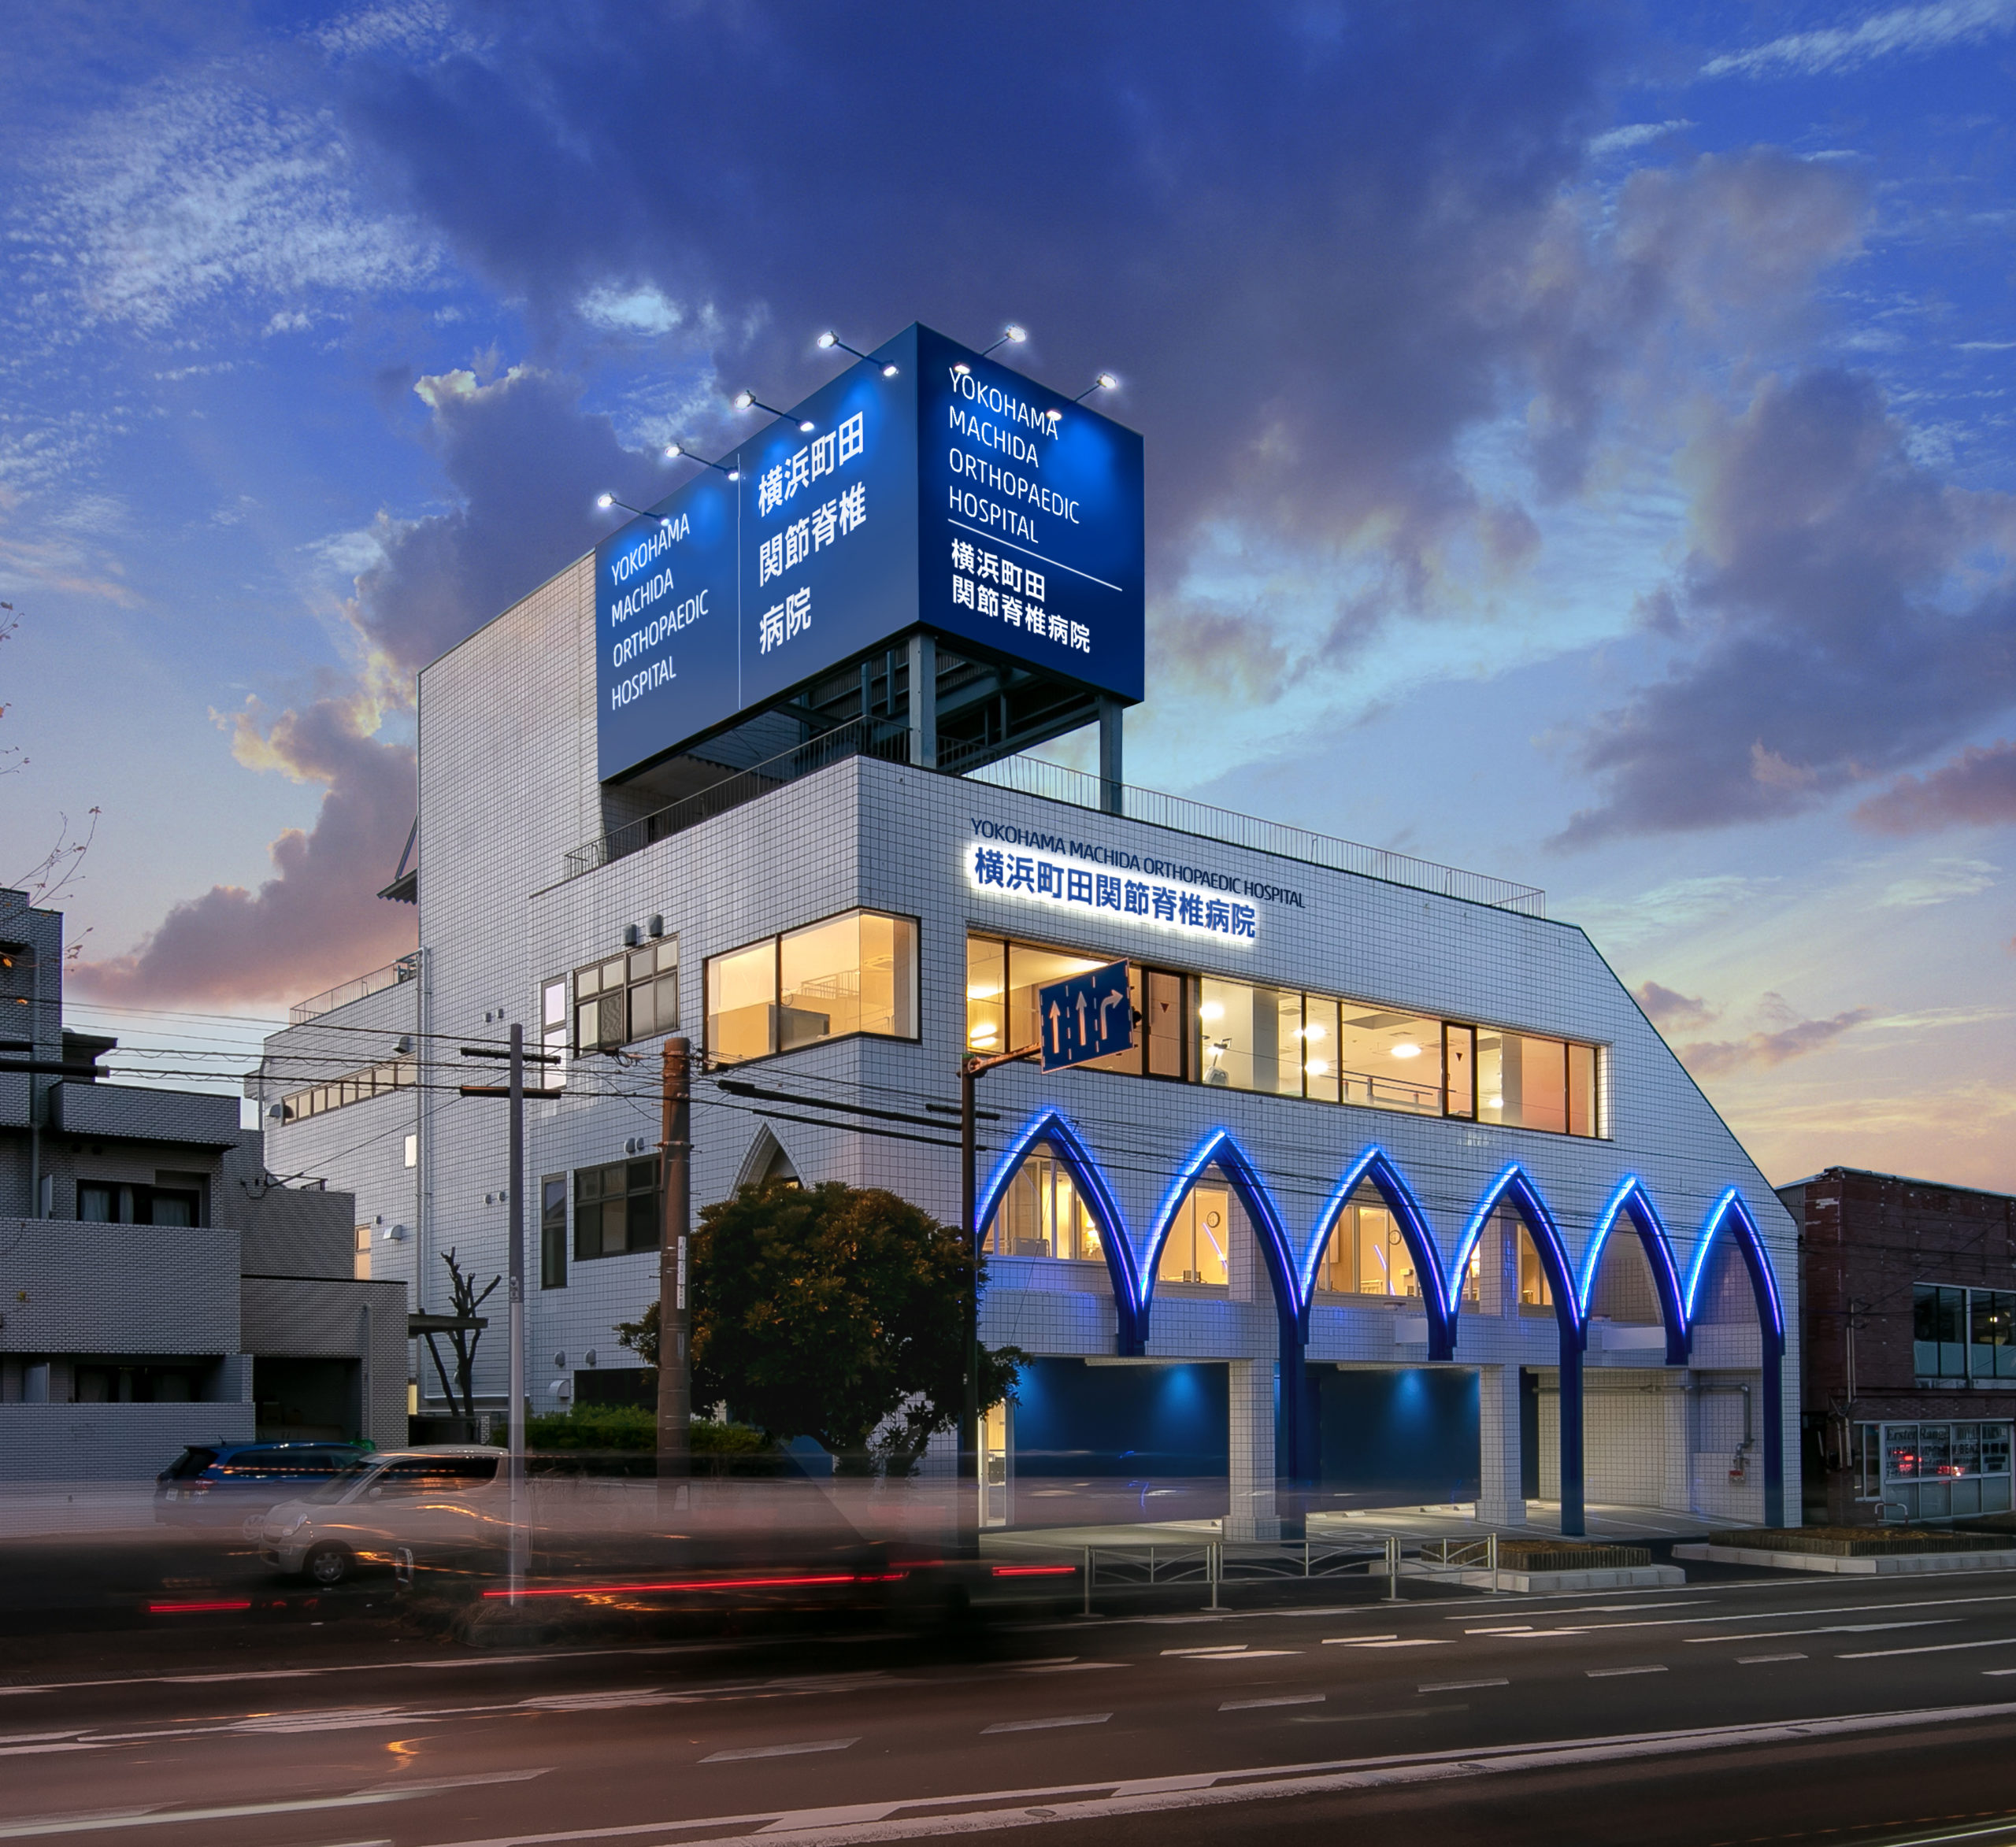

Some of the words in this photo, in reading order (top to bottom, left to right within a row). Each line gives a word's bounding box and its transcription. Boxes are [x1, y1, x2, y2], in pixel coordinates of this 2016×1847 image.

[949, 367, 1058, 440] YOKOHAMA
[950, 405, 1039, 468] MACHIDA
[758, 412, 865, 517] 横浜町田
[949, 447, 1080, 524] ORTHOPAEDIC
[611, 513, 690, 586] YOKOHAMA
[759, 481, 866, 587] 関節脊椎
[950, 486, 1039, 544] HOSPITAL
[611, 568, 674, 627] MACHIDA
[951, 538, 1046, 602] 横浜町田
[613, 589, 709, 668] ORTHOPAEDIC
[759, 587, 812, 655] 病院
[953, 574, 1091, 653] 関節脊椎病院
[612, 656, 676, 711] HOSPITAL
[970, 817, 1066, 855] YOKOHAMA
[1069, 840, 1141, 872] MACHIDA
[1143, 857, 1241, 894] ORTHOPAEDIC
[1243, 880, 1306, 909] HOSPITAL
[975, 846, 1256, 938] 横浜町田関節脊椎病院
